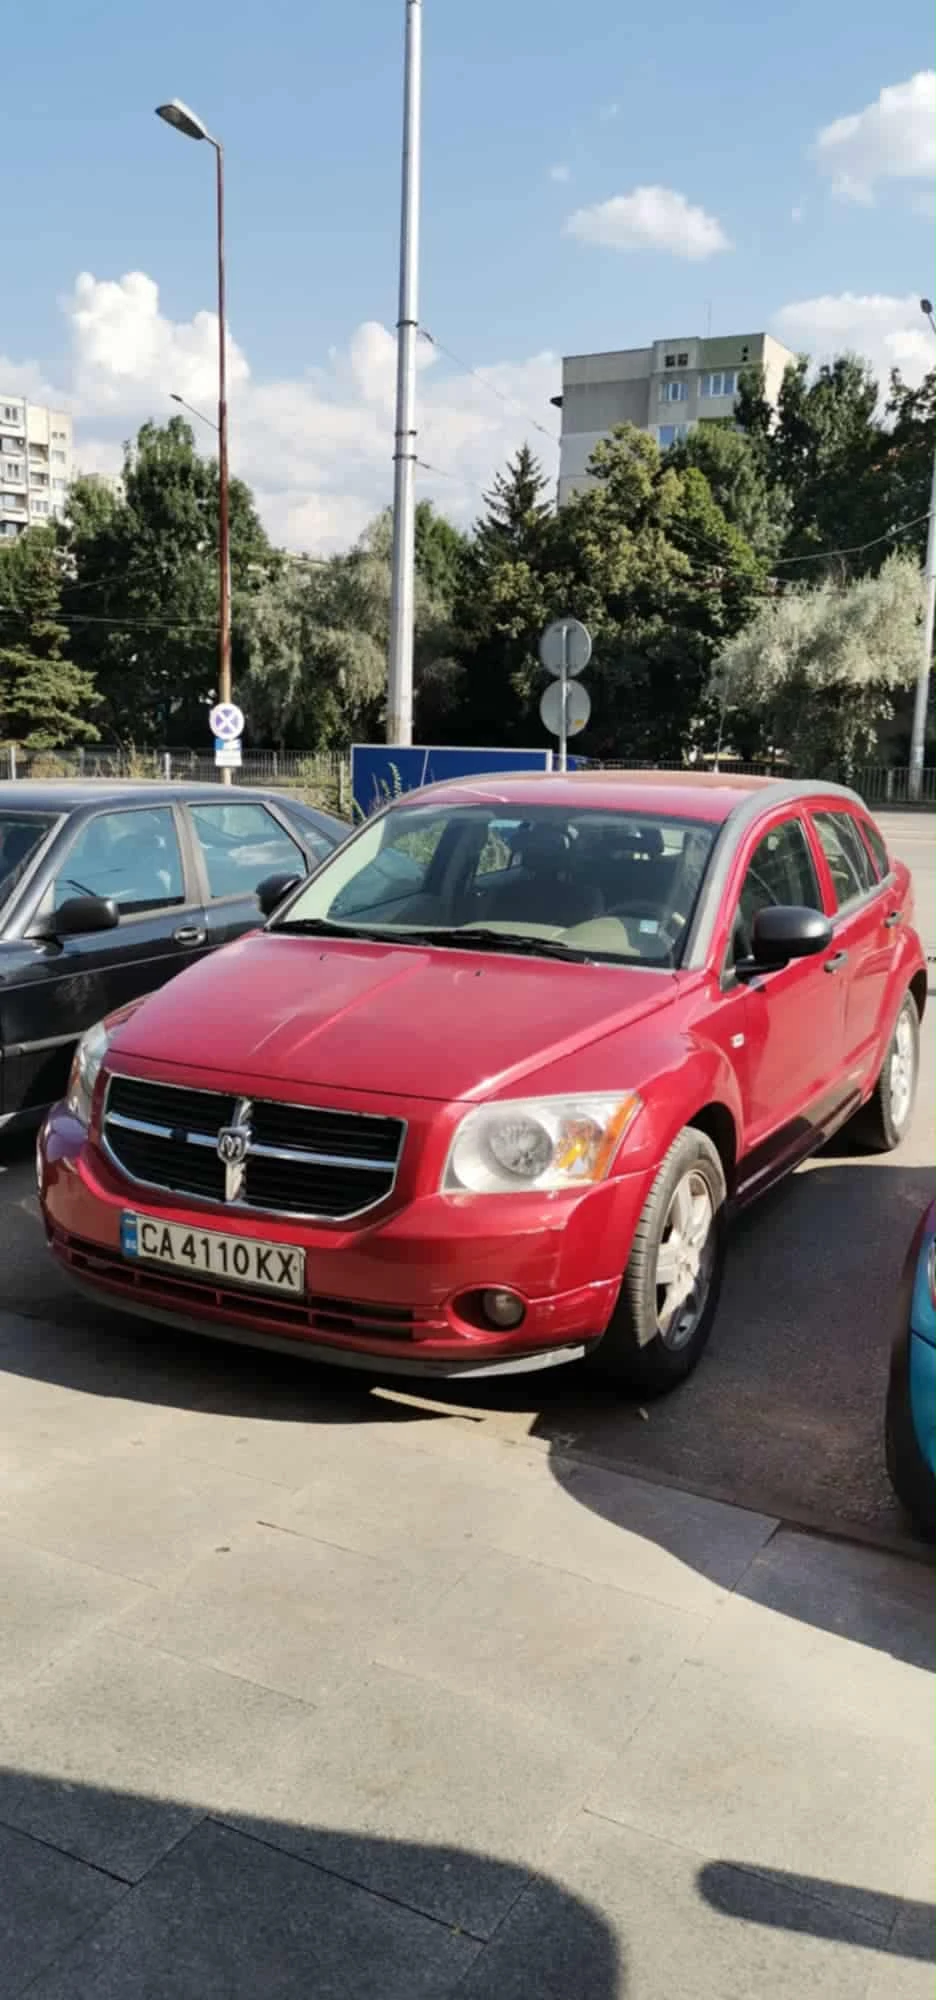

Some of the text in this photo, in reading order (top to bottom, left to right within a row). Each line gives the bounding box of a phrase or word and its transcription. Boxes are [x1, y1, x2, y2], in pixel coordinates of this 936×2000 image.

[142, 1224, 294, 1285] CA 4110 KX
